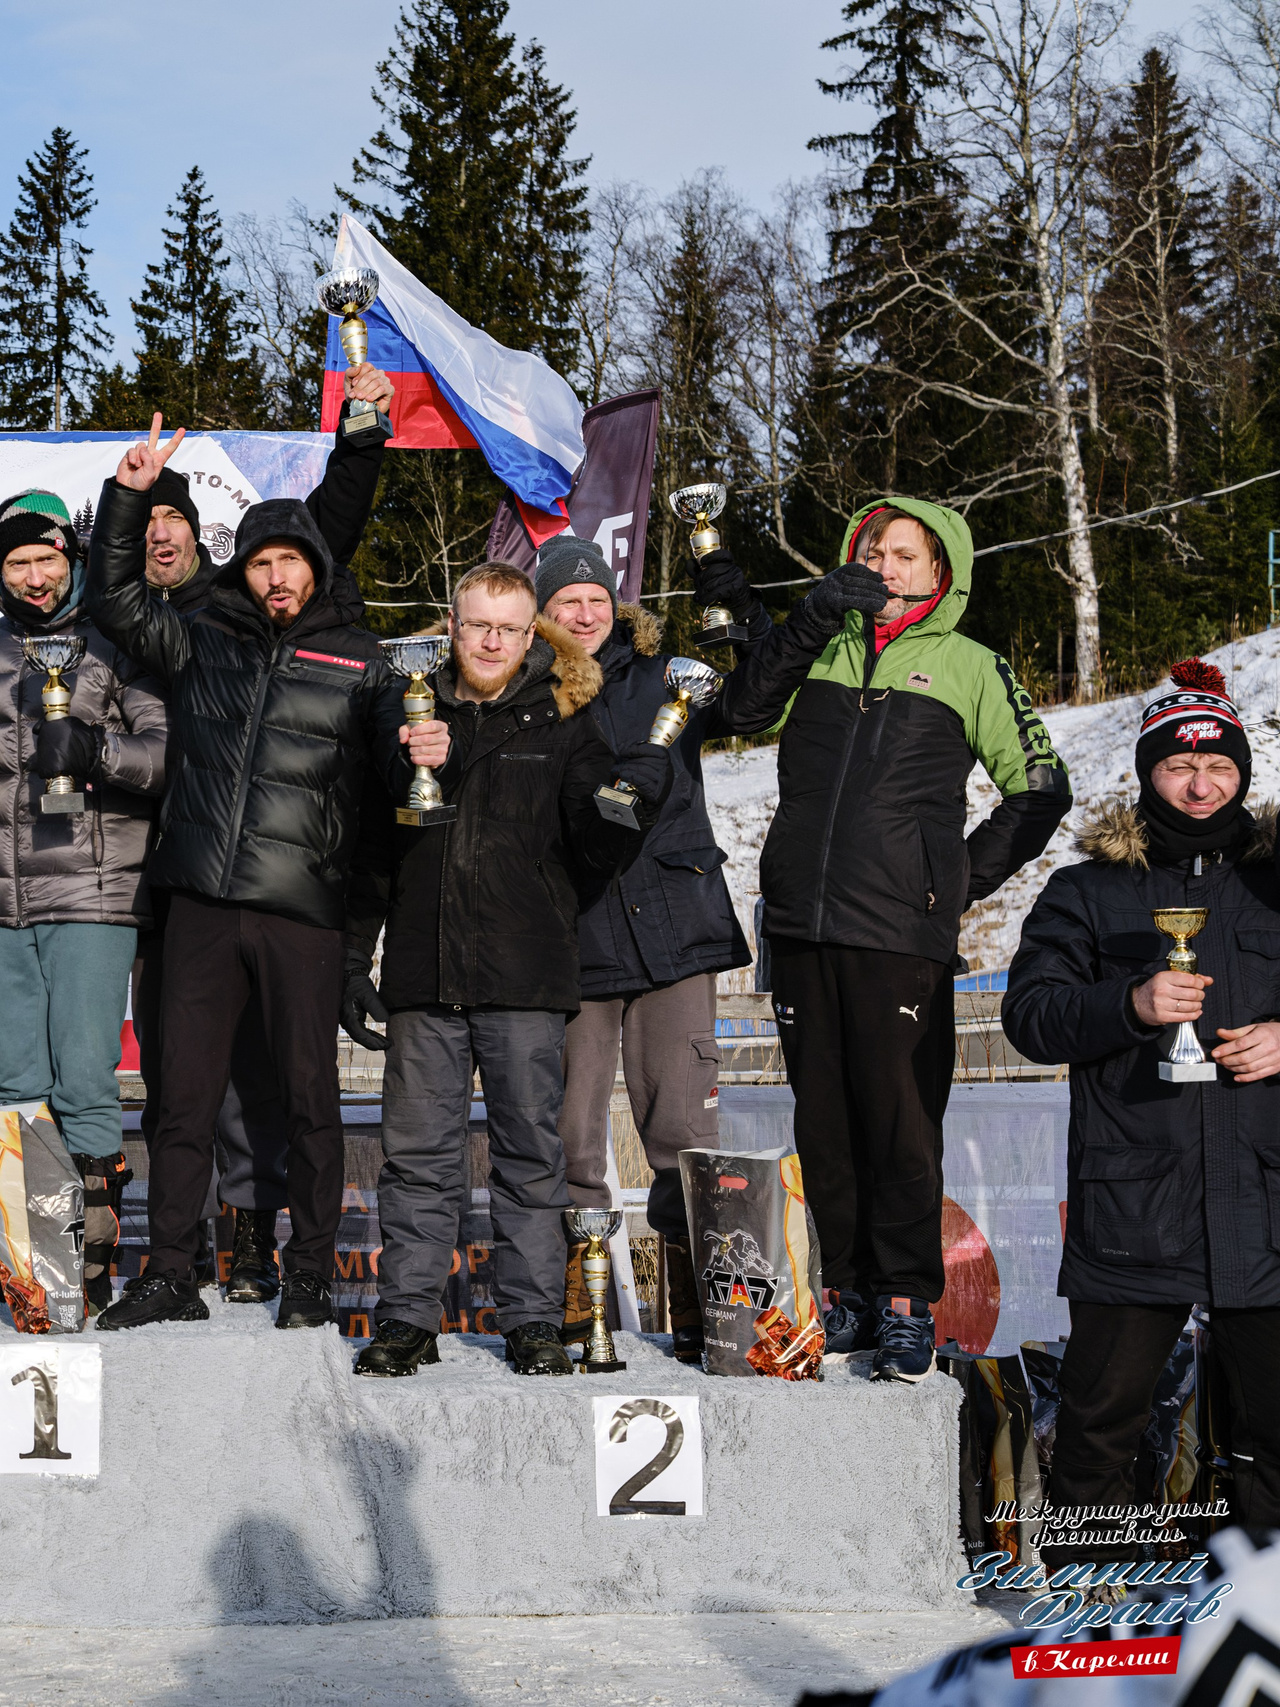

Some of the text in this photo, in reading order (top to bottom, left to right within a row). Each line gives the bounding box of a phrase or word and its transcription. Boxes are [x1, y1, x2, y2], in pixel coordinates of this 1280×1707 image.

[333, 658, 361, 667] PRADA
[1177, 722, 1216, 736] ДРИФТ
[705, 1307, 737, 1321] GERMANY
[10, 1365, 72, 1460] 1
[608, 1398, 687, 1516] 2
